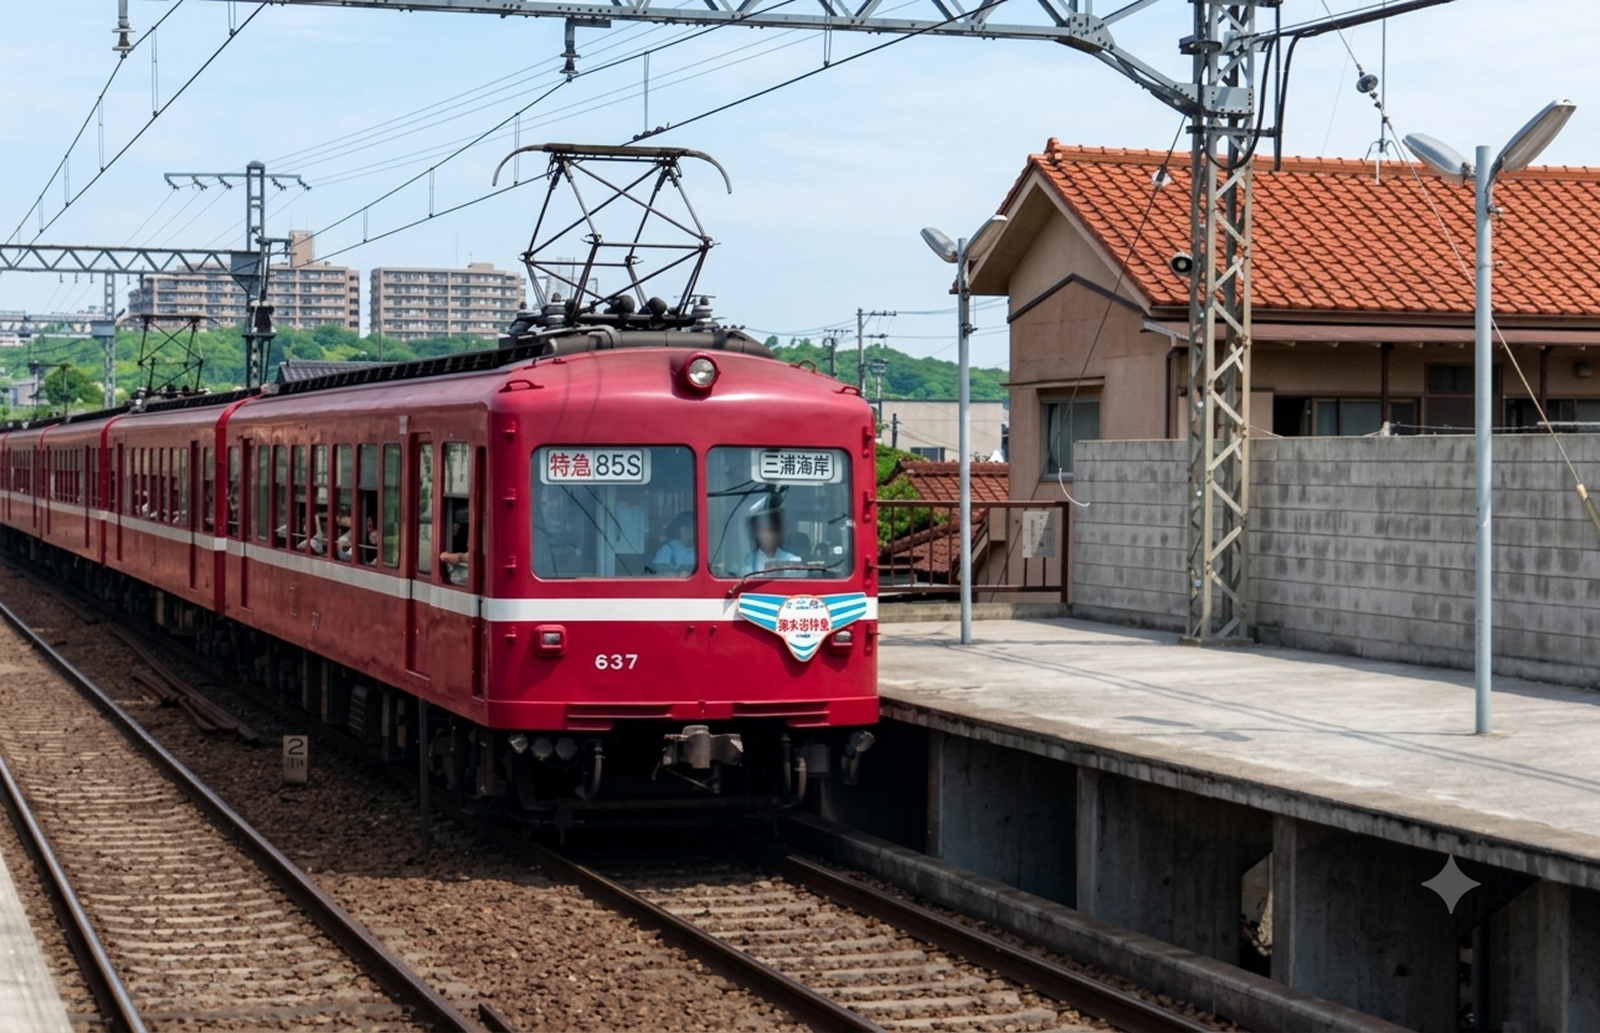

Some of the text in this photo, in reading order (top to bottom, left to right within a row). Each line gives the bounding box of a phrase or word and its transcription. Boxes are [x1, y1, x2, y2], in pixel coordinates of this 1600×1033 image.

[550, 453, 641, 477] 特急 85S
[764, 454, 830, 476] 三浦海岸
[595, 654, 638, 670] 637
[288, 738, 304, 755] 2
